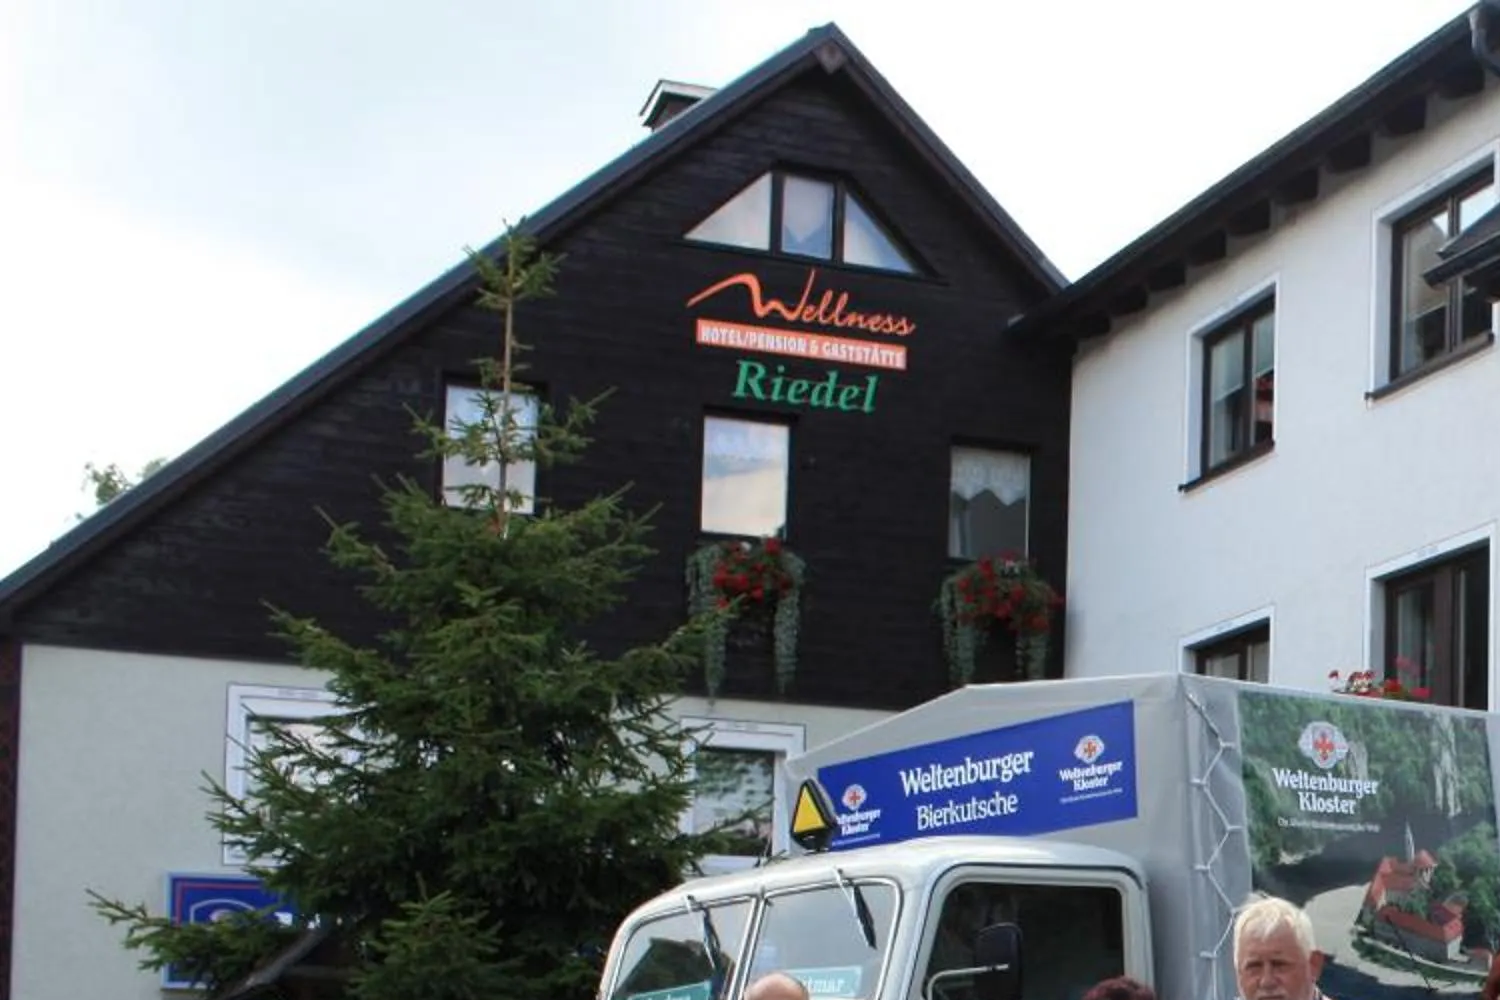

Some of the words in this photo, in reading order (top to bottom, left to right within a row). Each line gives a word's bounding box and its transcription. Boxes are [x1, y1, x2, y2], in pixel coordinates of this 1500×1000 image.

[686, 268, 917, 336] Wellness
[701, 326, 809, 353] HOTEL/PENSION
[731, 358, 881, 412] Riedel
[899, 750, 1034, 797] Weltenburger
[1271, 767, 1379, 799] Weltenburger
[916, 790, 1019, 830] Bierkutsche
[1298, 791, 1357, 814] Kloster
